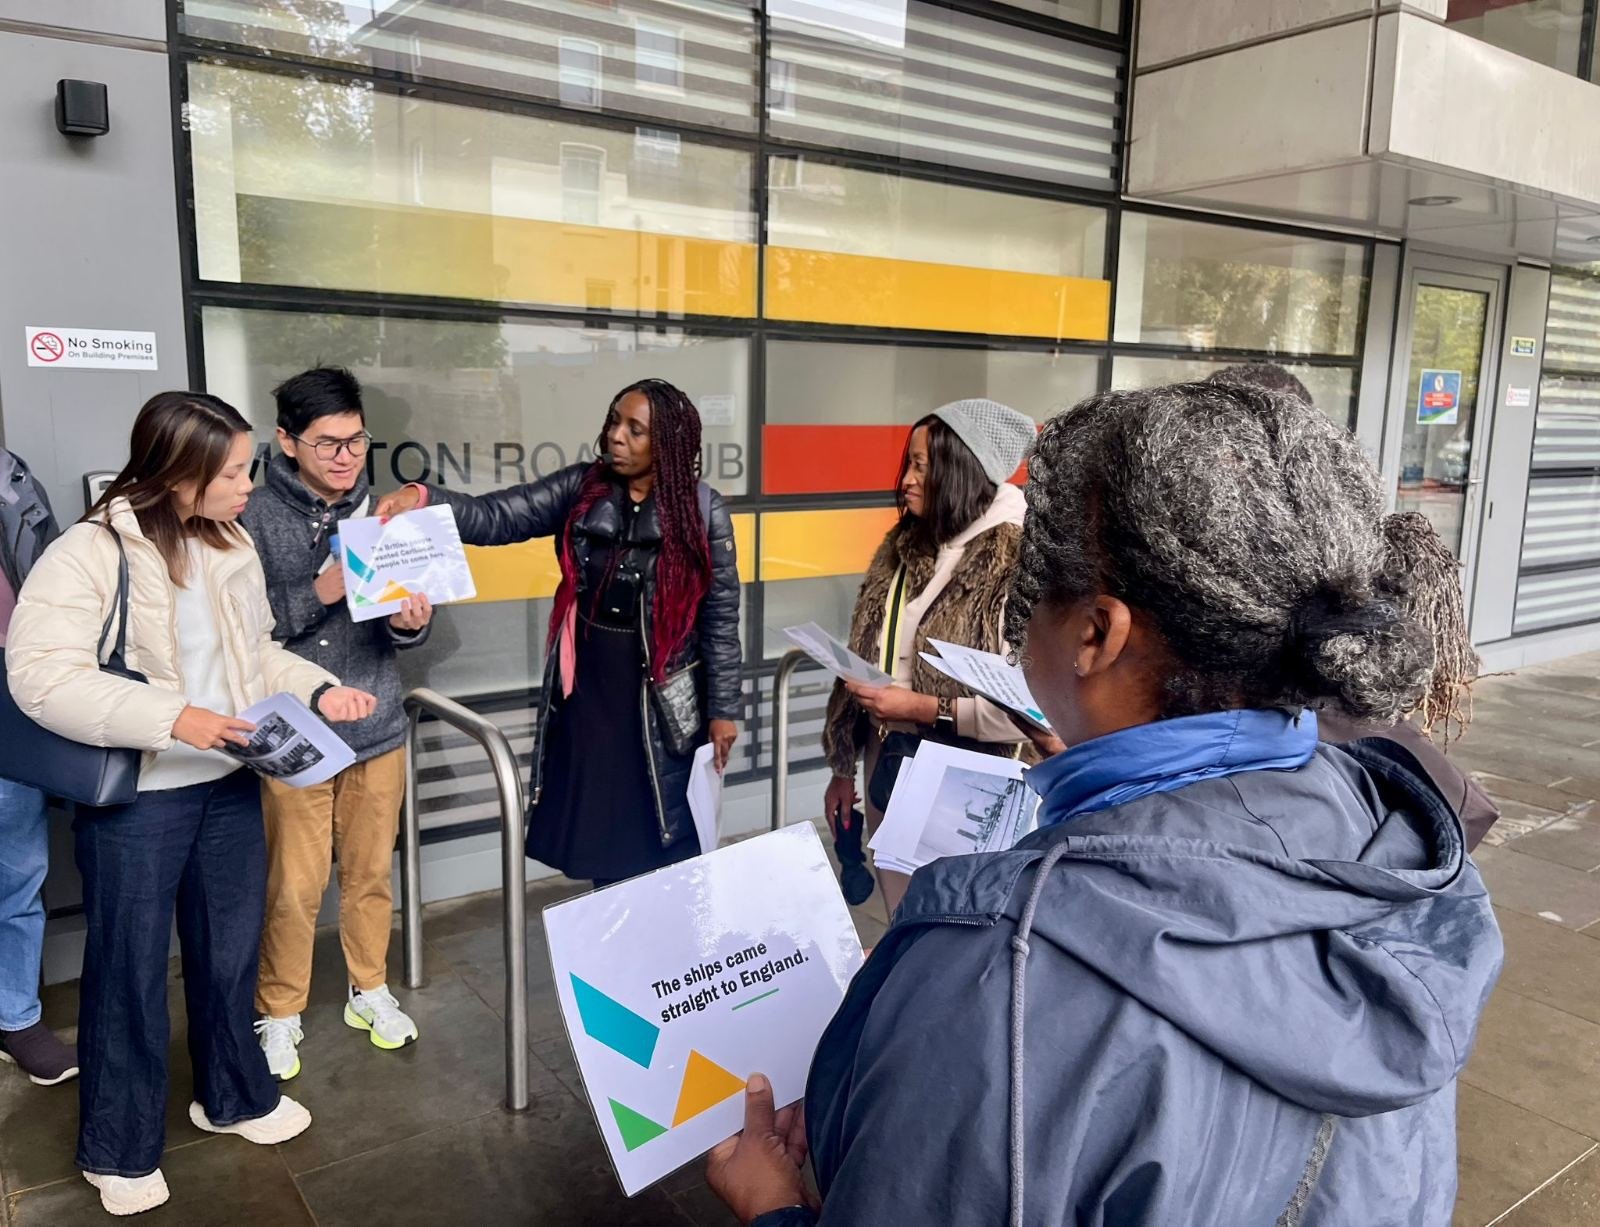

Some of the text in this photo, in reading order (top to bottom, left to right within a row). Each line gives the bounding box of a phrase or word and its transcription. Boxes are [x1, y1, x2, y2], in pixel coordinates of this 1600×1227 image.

[68, 337, 152, 354] No Smoking
[82, 351, 115, 361] Building
[118, 353, 154, 361] Premises
[376, 561, 400, 570] people
[651, 943, 767, 999] The ships came
[661, 948, 809, 1023] straight to England.
